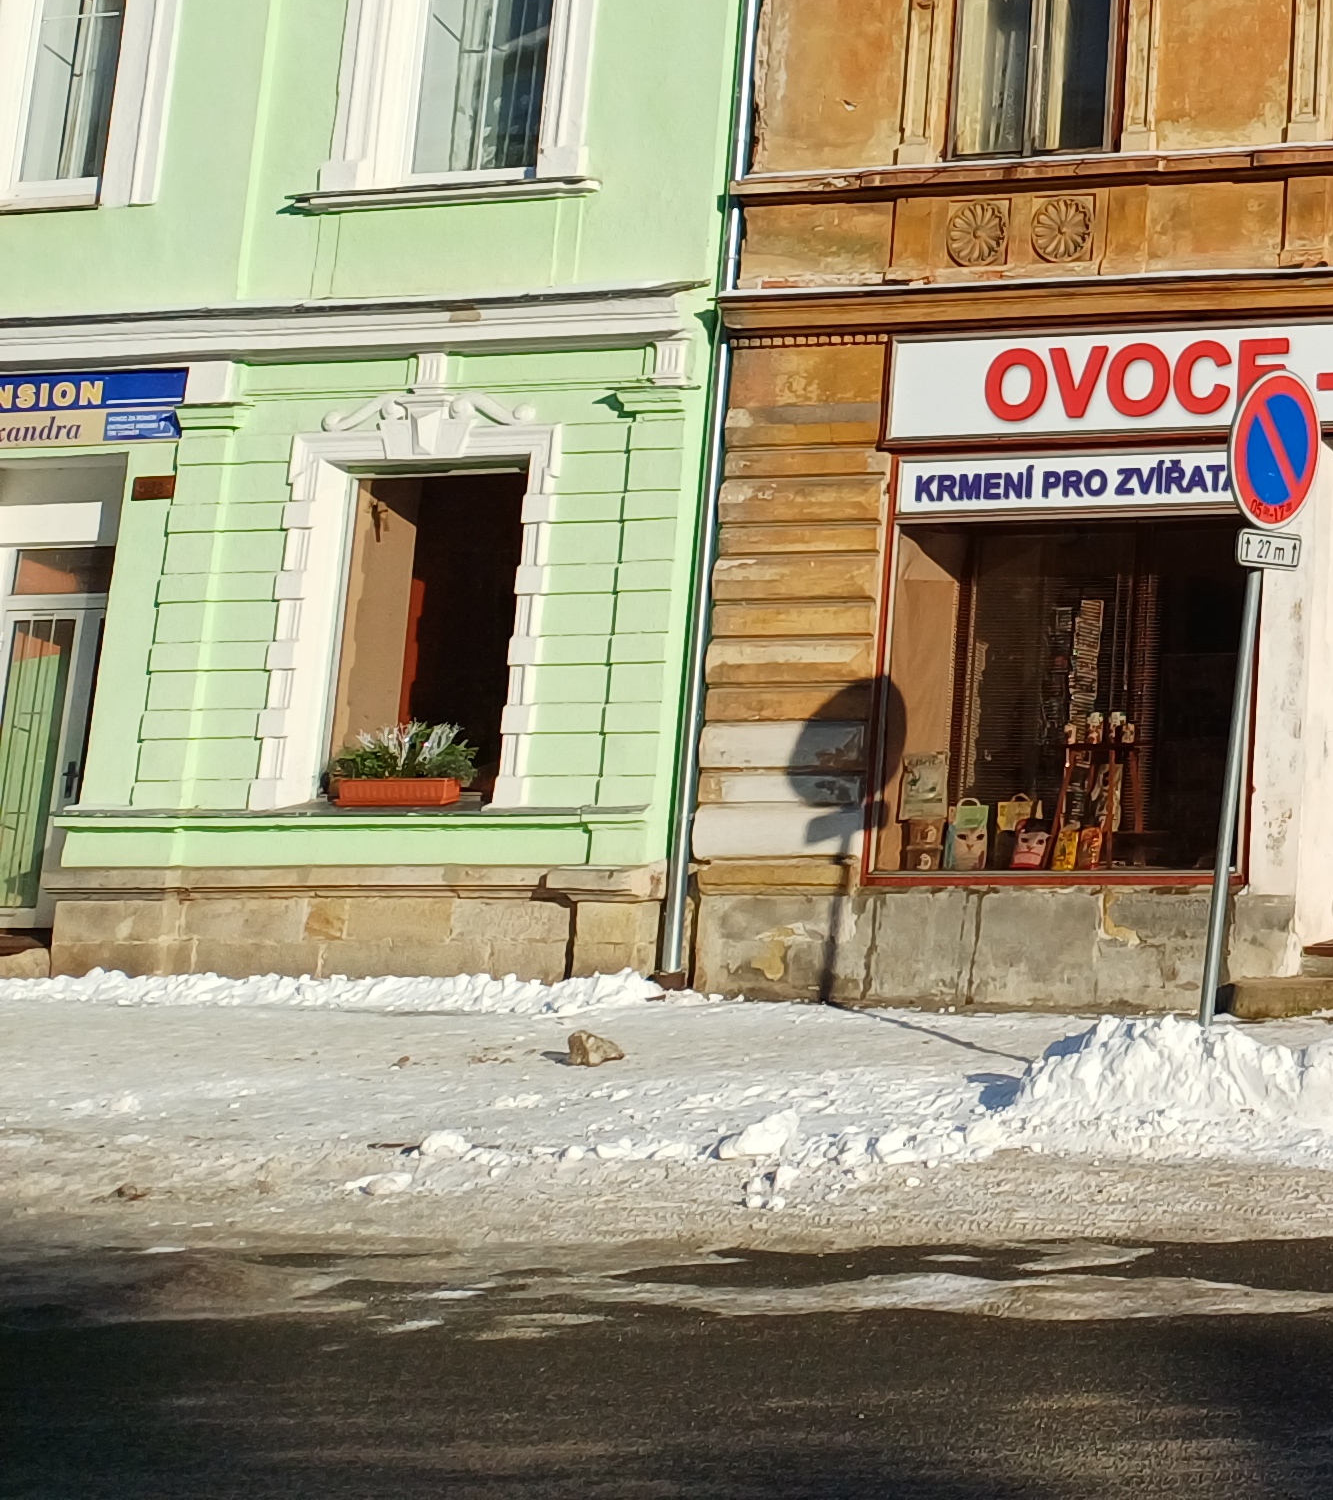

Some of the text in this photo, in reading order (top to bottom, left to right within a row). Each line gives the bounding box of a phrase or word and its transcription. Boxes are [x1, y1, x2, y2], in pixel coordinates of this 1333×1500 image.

[915, 464, 1035, 503] KRMENÍ
[1041, 469, 1109, 499] PRO
[1256, 538, 1285, 561] 27 m
